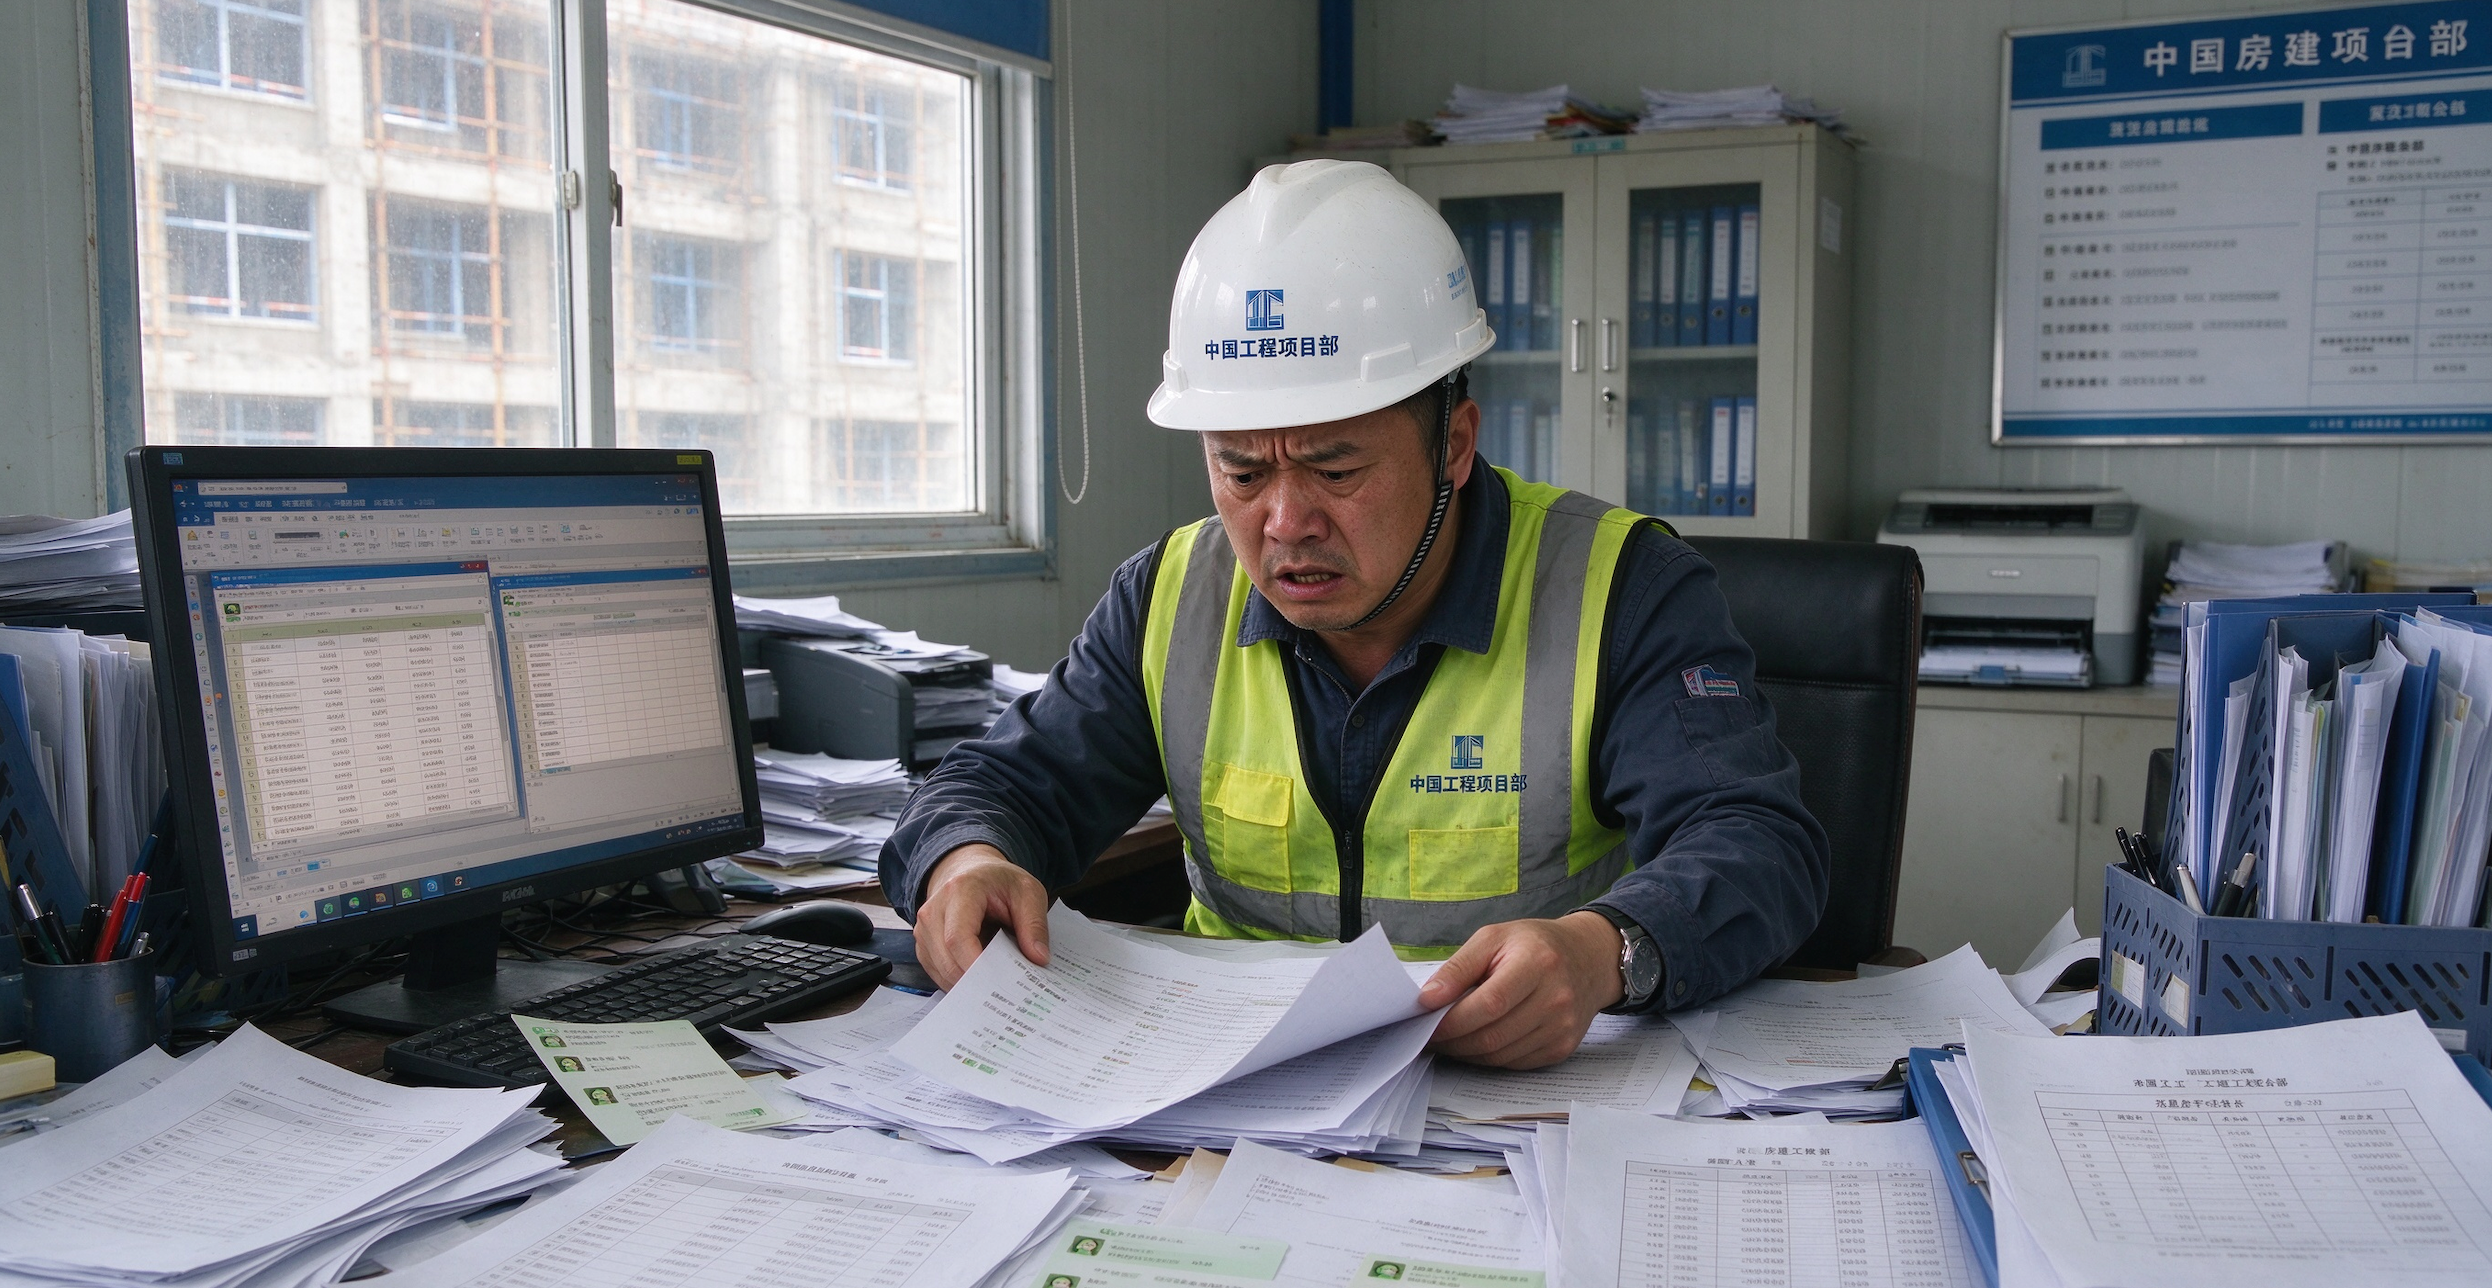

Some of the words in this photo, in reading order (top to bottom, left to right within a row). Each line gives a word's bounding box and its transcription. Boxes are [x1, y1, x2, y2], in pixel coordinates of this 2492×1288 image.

[1205, 334, 1339, 360] 中国工程项目部
[1410, 773, 1528, 793] 中国工程项目部
